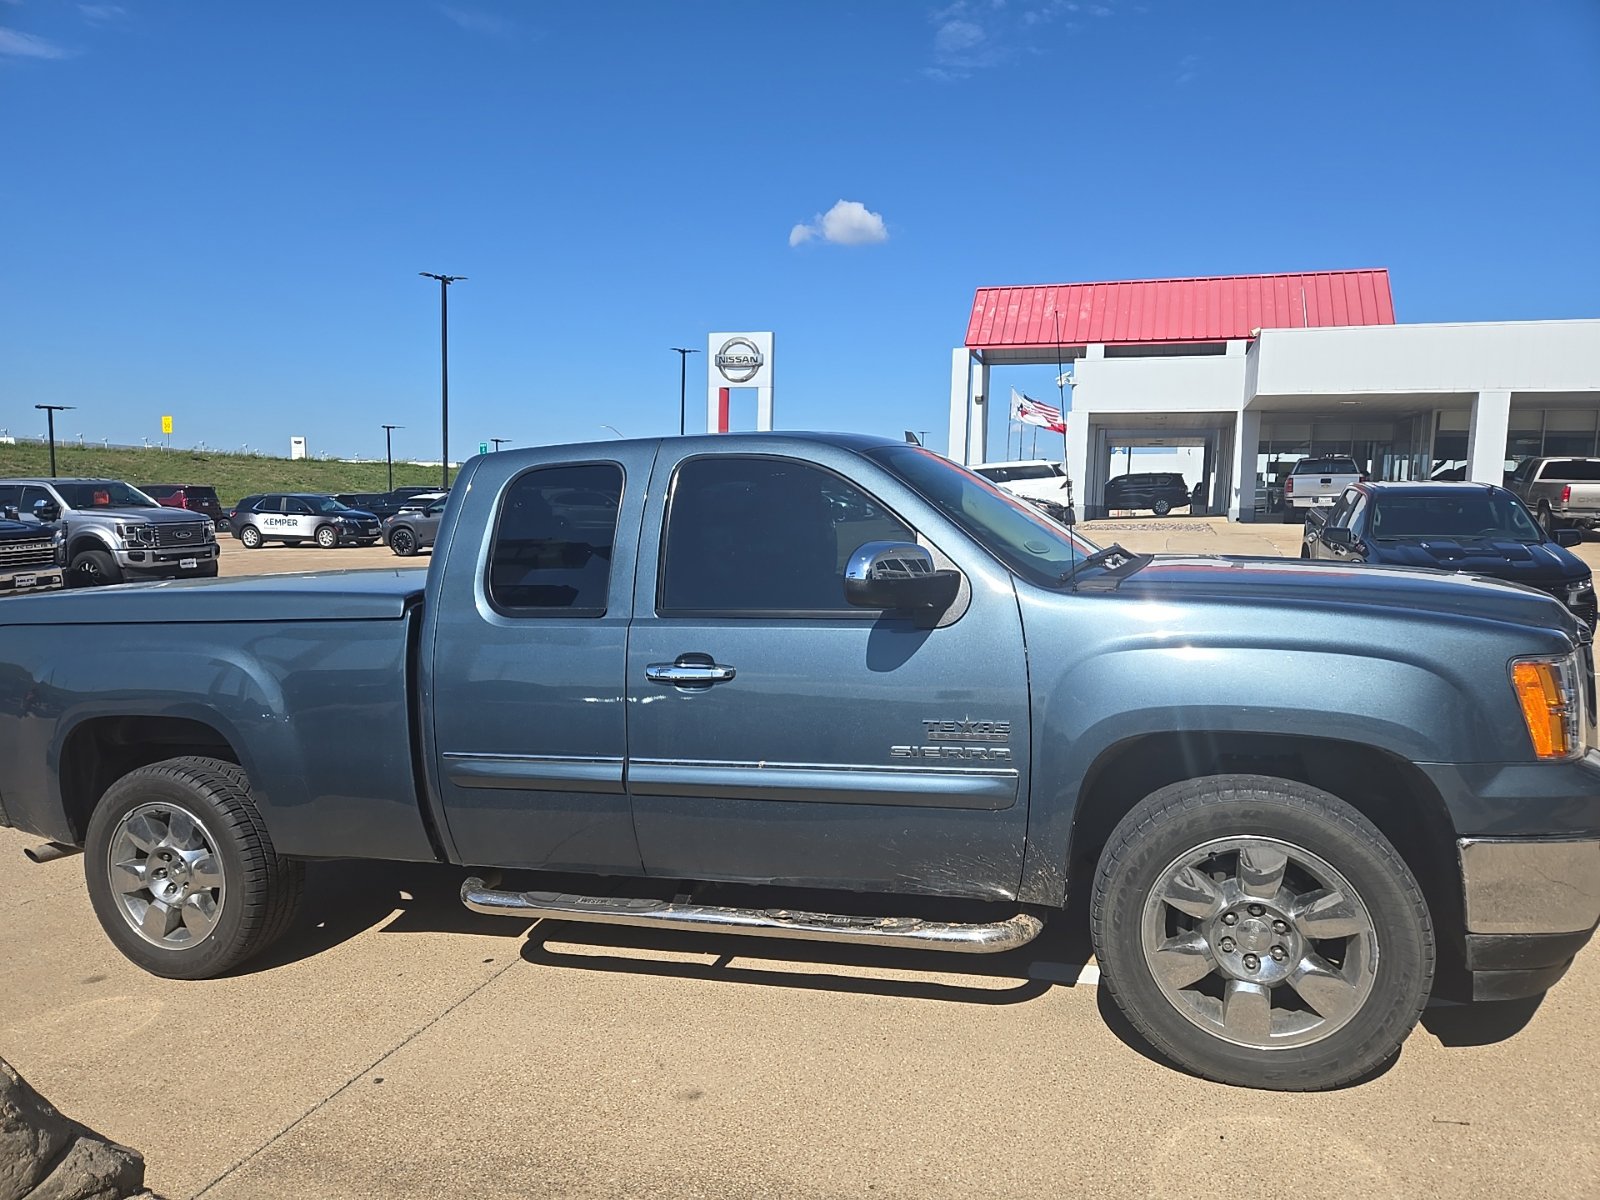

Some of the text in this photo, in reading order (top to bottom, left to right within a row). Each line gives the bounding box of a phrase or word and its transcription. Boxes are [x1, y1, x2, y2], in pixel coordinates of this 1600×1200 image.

[718, 355, 758, 364] NISSAN
[263, 517, 298, 527] KEMPER
[922, 715, 1011, 734] TEXAS
[890, 745, 1012, 761] SIERRA
